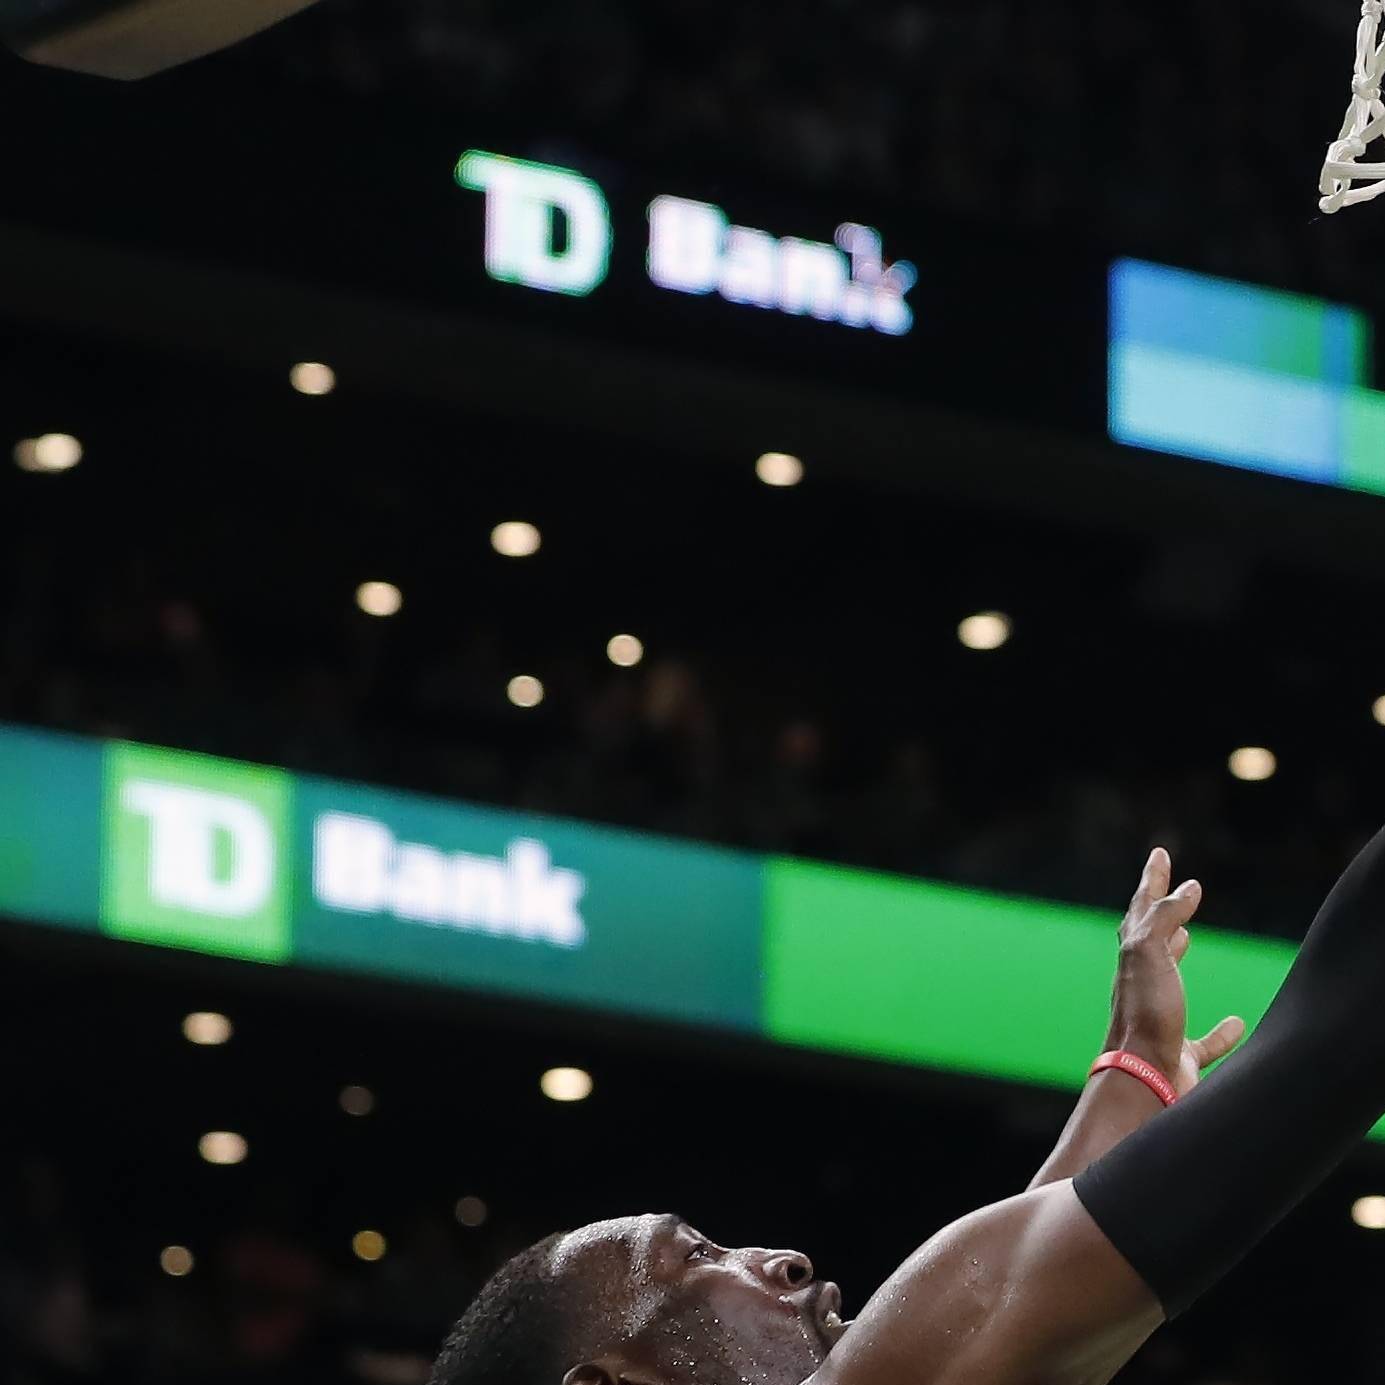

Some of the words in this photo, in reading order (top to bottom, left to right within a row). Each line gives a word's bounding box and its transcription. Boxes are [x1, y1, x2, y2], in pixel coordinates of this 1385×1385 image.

[453, 149, 611, 296] TD
[646, 193, 916, 336] Bank
[119, 777, 274, 919] TD
[312, 808, 586, 948] Bank
